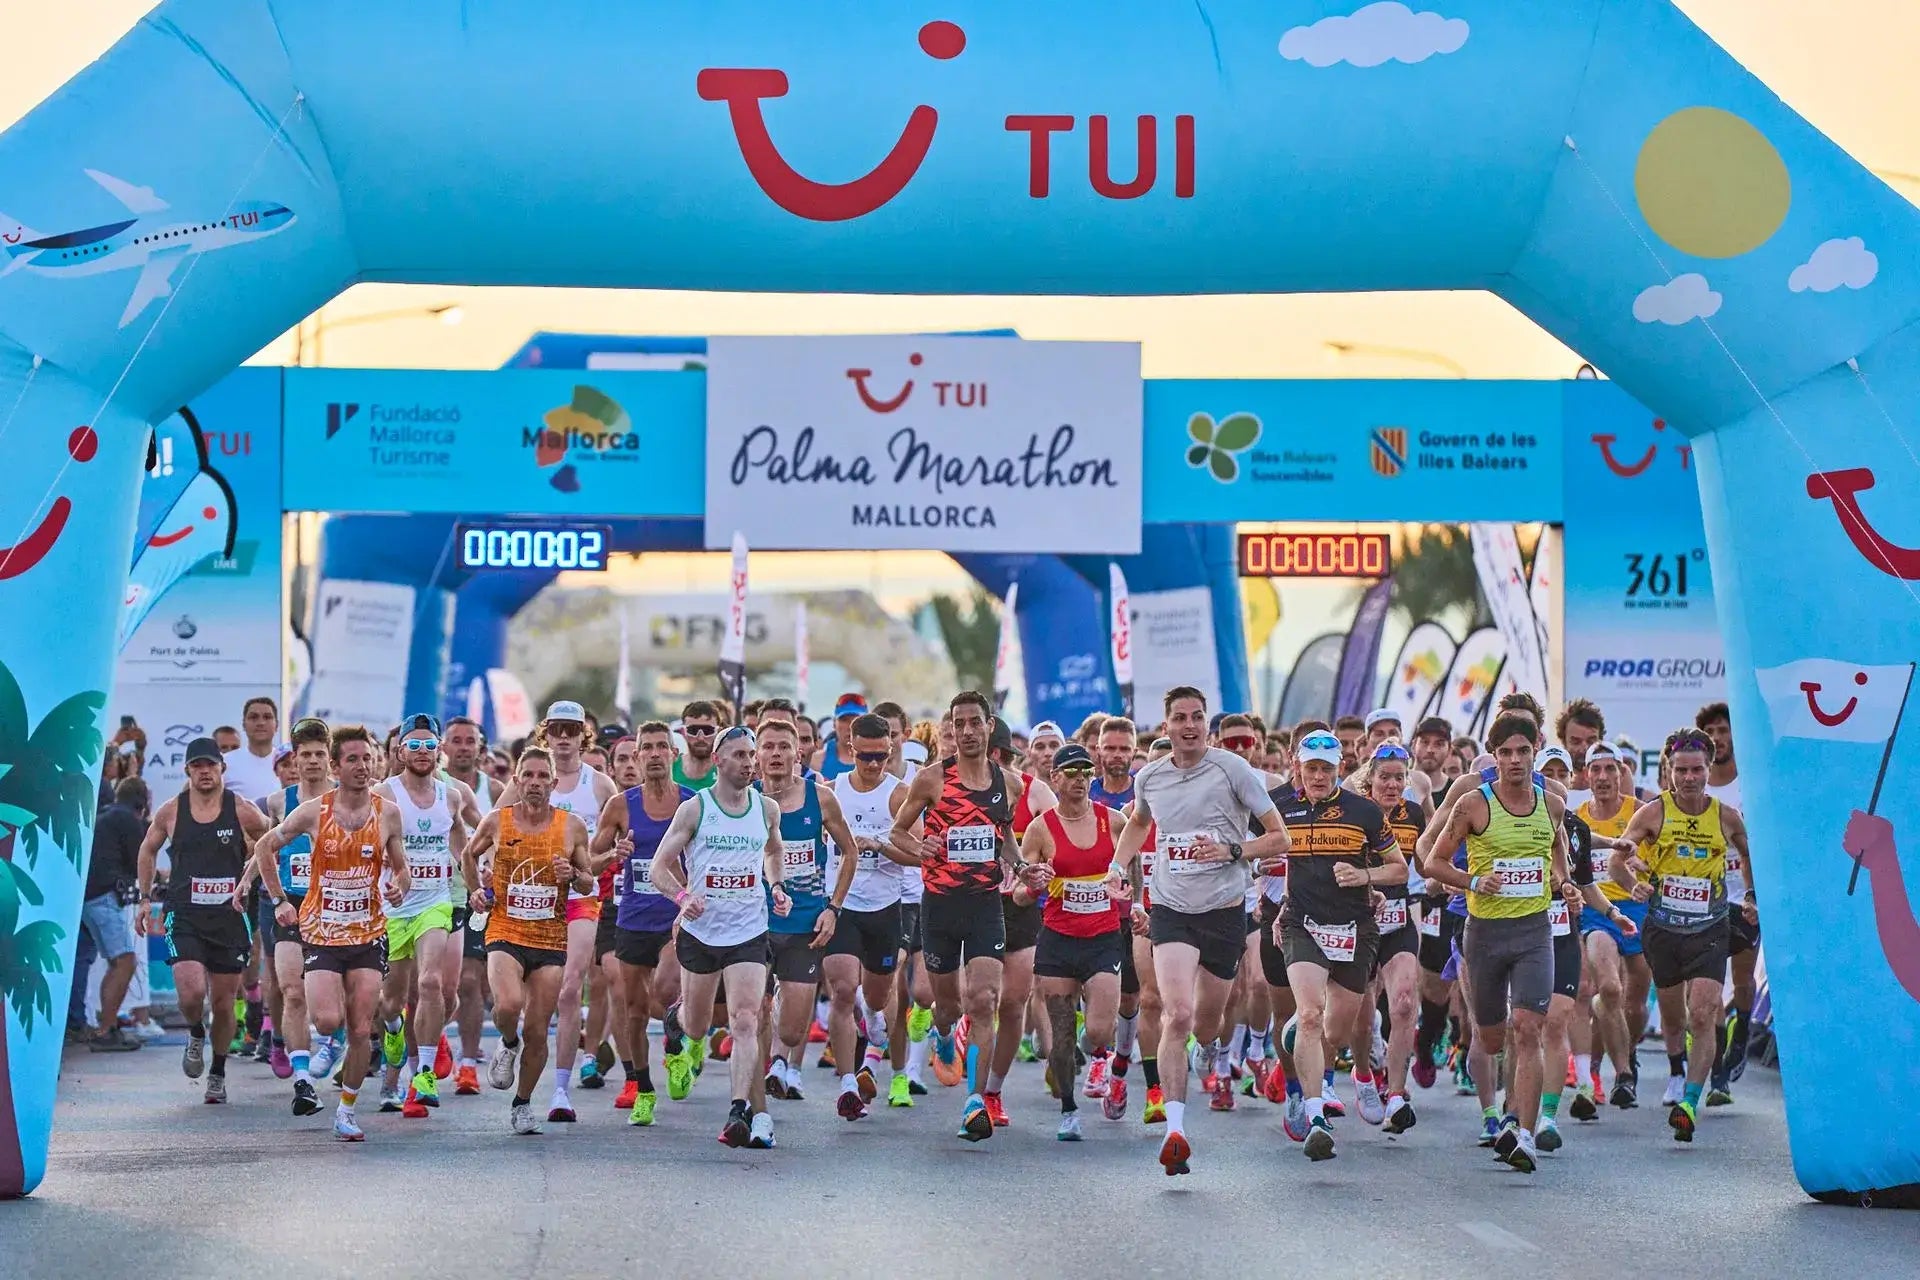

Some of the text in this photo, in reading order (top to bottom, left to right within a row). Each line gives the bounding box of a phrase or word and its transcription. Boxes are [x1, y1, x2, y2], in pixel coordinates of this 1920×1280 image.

[1005, 115, 1195, 199] TUI
[229, 211, 259, 229] TUI
[933, 382, 988, 407] TUI
[370, 402, 462, 422] Fundació
[370, 425, 456, 445] Mallorca
[522, 427, 640, 450] Mallorca
[1418, 429, 1538, 448] Govern de les
[203, 432, 251, 456] TUI
[368, 446, 451, 466] Turisme
[731, 424, 1118, 493] Palma Marathon
[1418, 453, 1528, 469] Illes Balears
[852, 505, 996, 528] MALLORCA
[150, 646, 220, 656] Port de Palma
[705, 835, 749, 845] HEATON
[954, 838, 990, 851] 1216
[1305, 833, 1351, 846] Radkurier
[411, 866, 438, 878] 013
[197, 883, 230, 893] 6709
[712, 876, 749, 888] 5821
[1068, 891, 1105, 903] 5058
[1668, 886, 1704, 901] 6642
[327, 899, 365, 911] 4816
[513, 897, 550, 909] 5850
